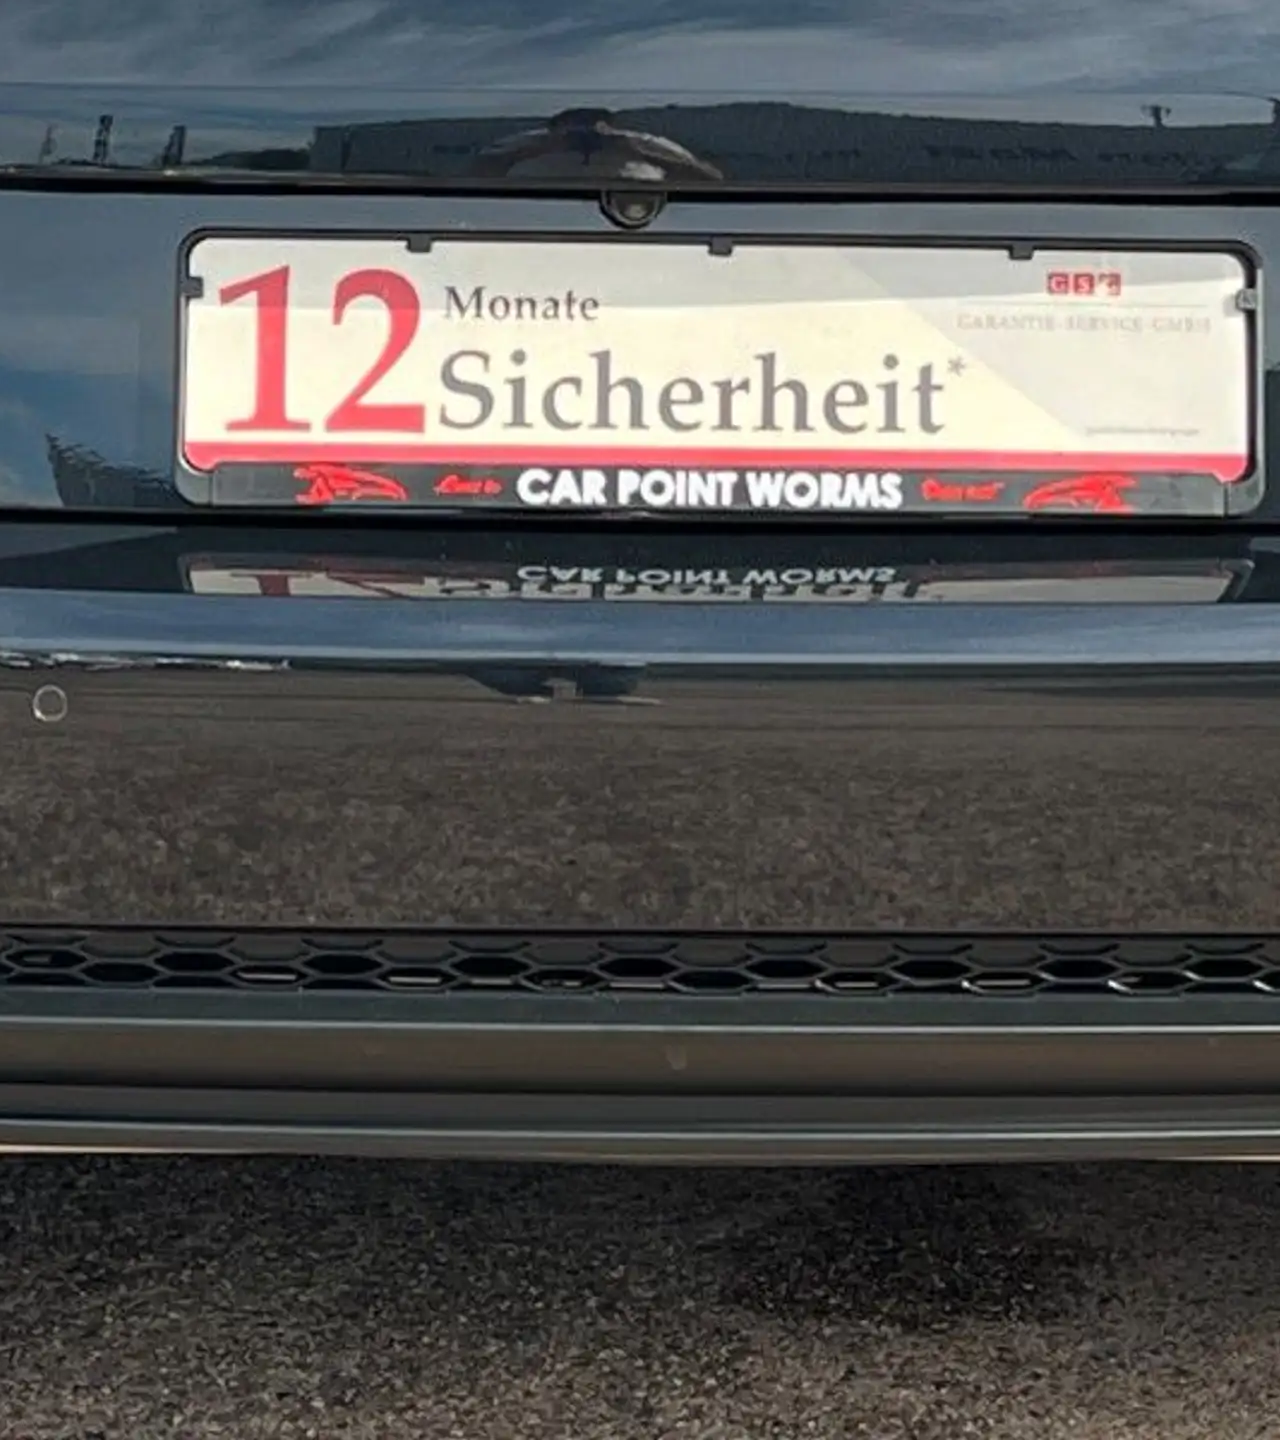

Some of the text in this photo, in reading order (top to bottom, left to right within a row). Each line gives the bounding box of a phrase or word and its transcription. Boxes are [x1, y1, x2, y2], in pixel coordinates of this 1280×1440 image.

[443, 286, 600, 321] Monate
[218, 264, 426, 434] 12
[516, 467, 608, 506] CAR
[616, 469, 740, 508] POINT
[746, 471, 904, 510] WORMS
